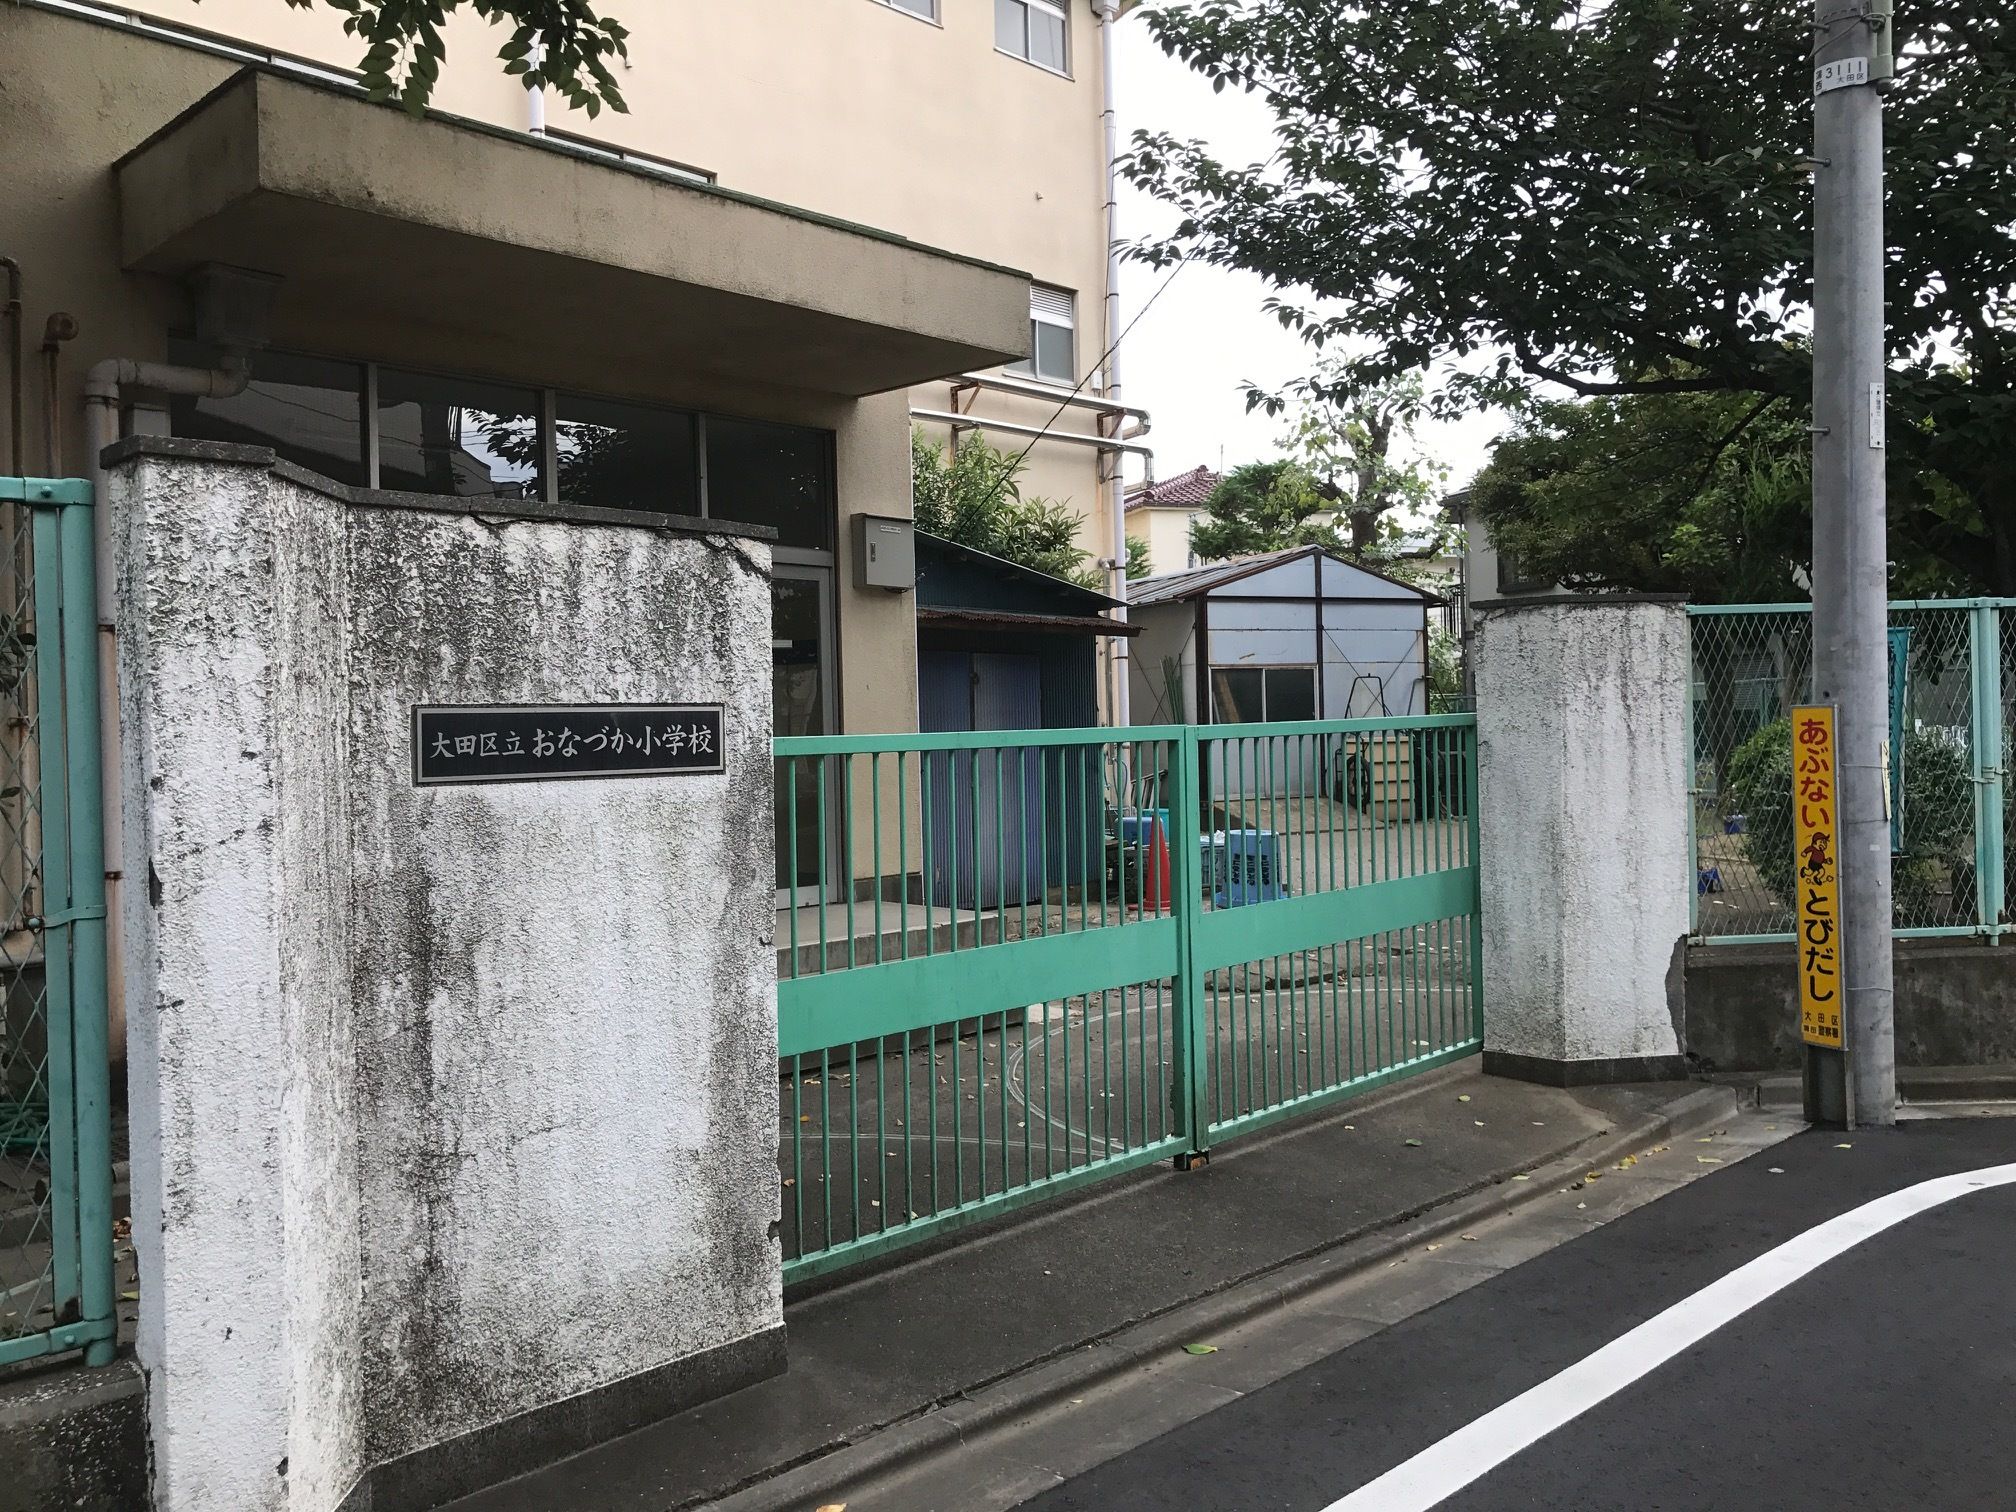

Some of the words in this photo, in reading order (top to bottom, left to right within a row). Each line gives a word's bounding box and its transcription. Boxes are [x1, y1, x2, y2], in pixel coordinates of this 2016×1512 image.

[1825, 61, 1862, 79] 3111
[1836, 73, 1864, 83] 大田区
[429, 723, 714, 759] 大田区立おなづか小学校
[1799, 718, 1830, 828] あぶない
[1804, 888, 1834, 1002] とびだし
[1804, 1011, 1839, 1026] 大田区
